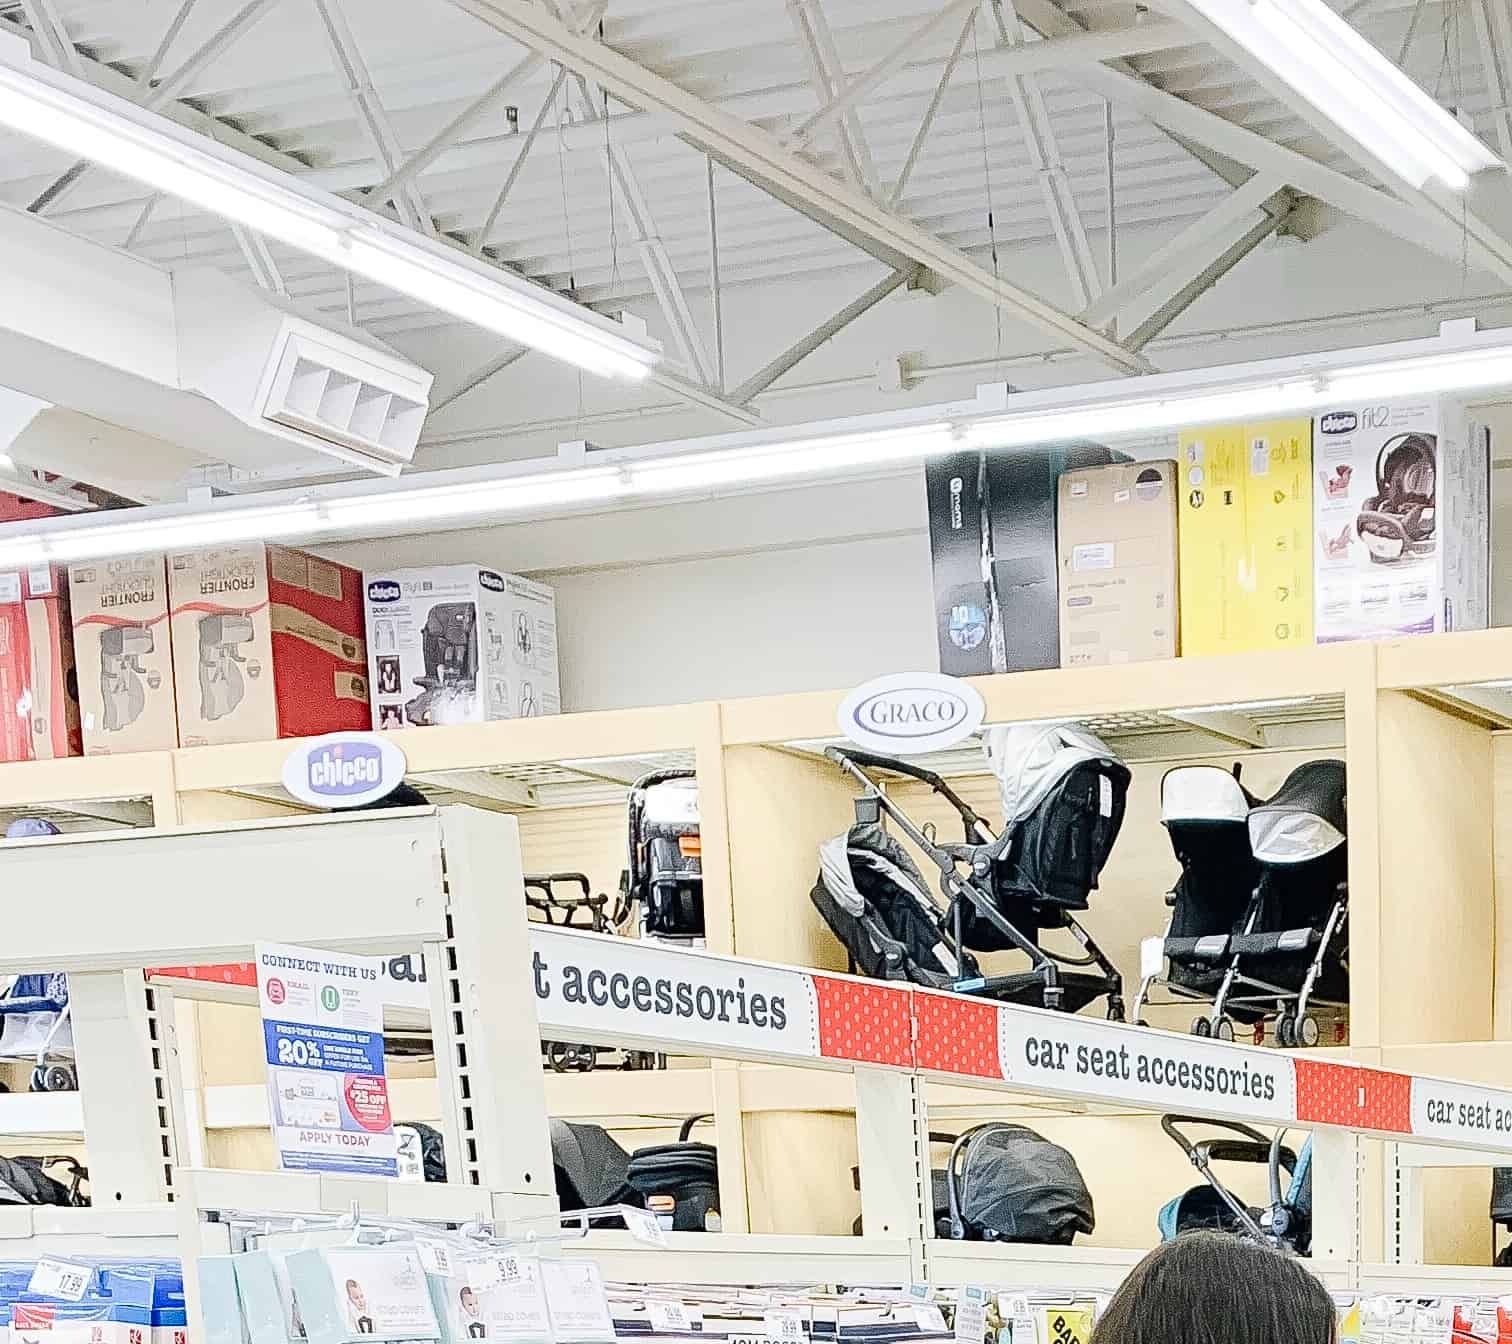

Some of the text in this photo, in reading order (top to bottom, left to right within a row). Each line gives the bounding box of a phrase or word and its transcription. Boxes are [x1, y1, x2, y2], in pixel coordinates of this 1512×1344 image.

[101, 590, 155, 608] FRONTIER
[200, 576, 256, 595] FRONTIER
[870, 698, 955, 726] GRACO
[310, 746, 380, 788] chicco
[262, 954, 321, 973] CONNECT
[323, 963, 357, 978] WITH
[361, 968, 377, 981] US
[562, 963, 788, 1031] accessories
[278, 1038, 320, 1065] 20%
[1024, 1033, 1276, 1102] car seat accessories
[1425, 1098, 1453, 1125] car
[1458, 1101, 1491, 1130] seat
[300, 1131, 371, 1147] APPLY TODAY
